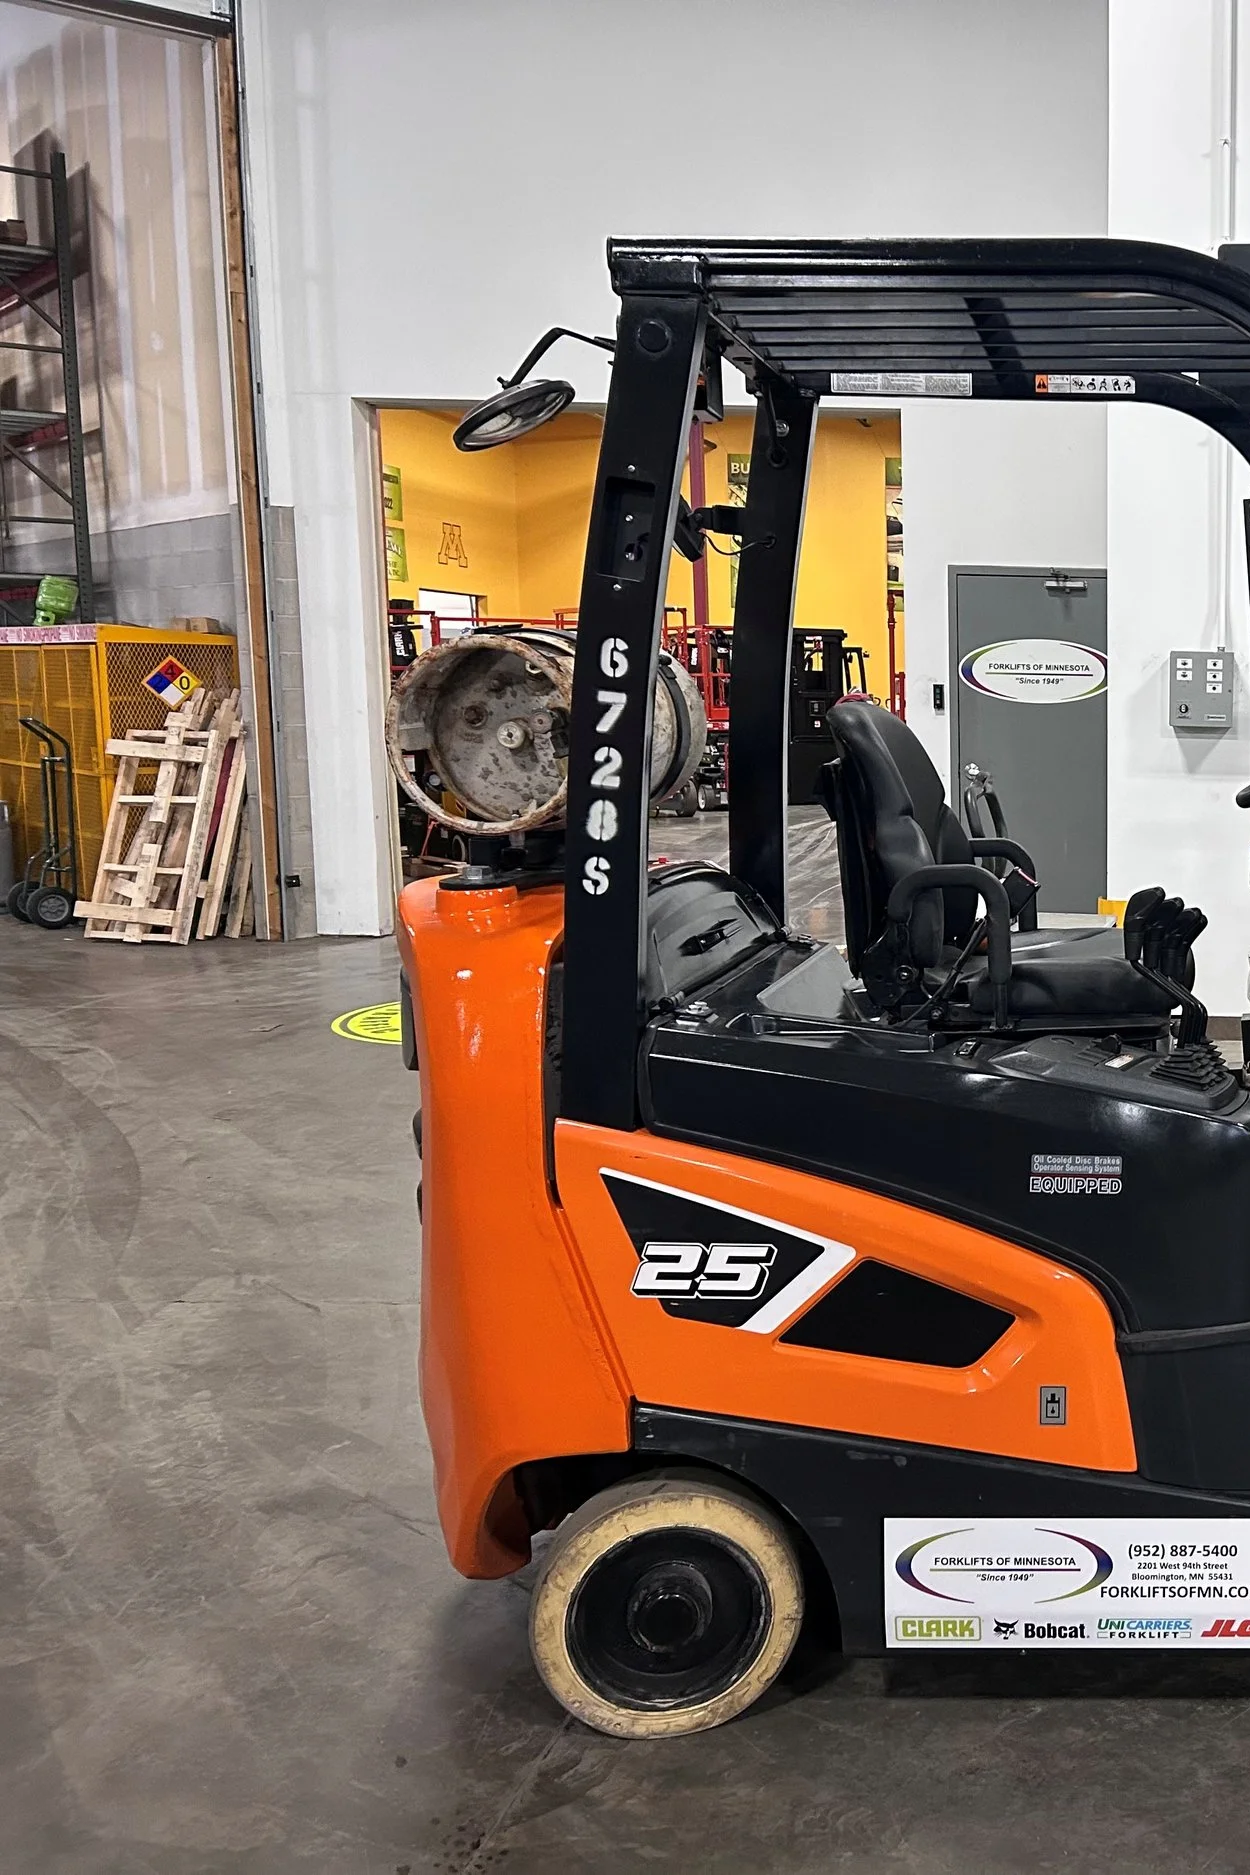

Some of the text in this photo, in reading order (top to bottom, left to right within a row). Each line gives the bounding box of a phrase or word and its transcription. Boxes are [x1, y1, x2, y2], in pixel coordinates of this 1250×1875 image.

[165, 665, 177, 677] 4
[988, 663, 1032, 671] FORKLIFTS
[1045, 664, 1090, 672] MINNESOTA
[179, 676, 190, 690] 0
[1034, 1155, 1120, 1165] Oil Cooled Disc Brakes
[1034, 1163, 1120, 1173] Operator Sensing System
[1029, 1176, 1122, 1195] EQUIPPED
[631, 1242, 777, 1299] 25
[1128, 1543, 1238, 1559] (952) 887-5400
[934, 1556, 1077, 1567] FORKLIFTS OF MINNESOTA
[1137, 1562, 1228, 1570] 2201 West 94th Street
[1131, 1573, 1233, 1582] Bloomington, MN 55431
[902, 1619, 975, 1637] CLARK
